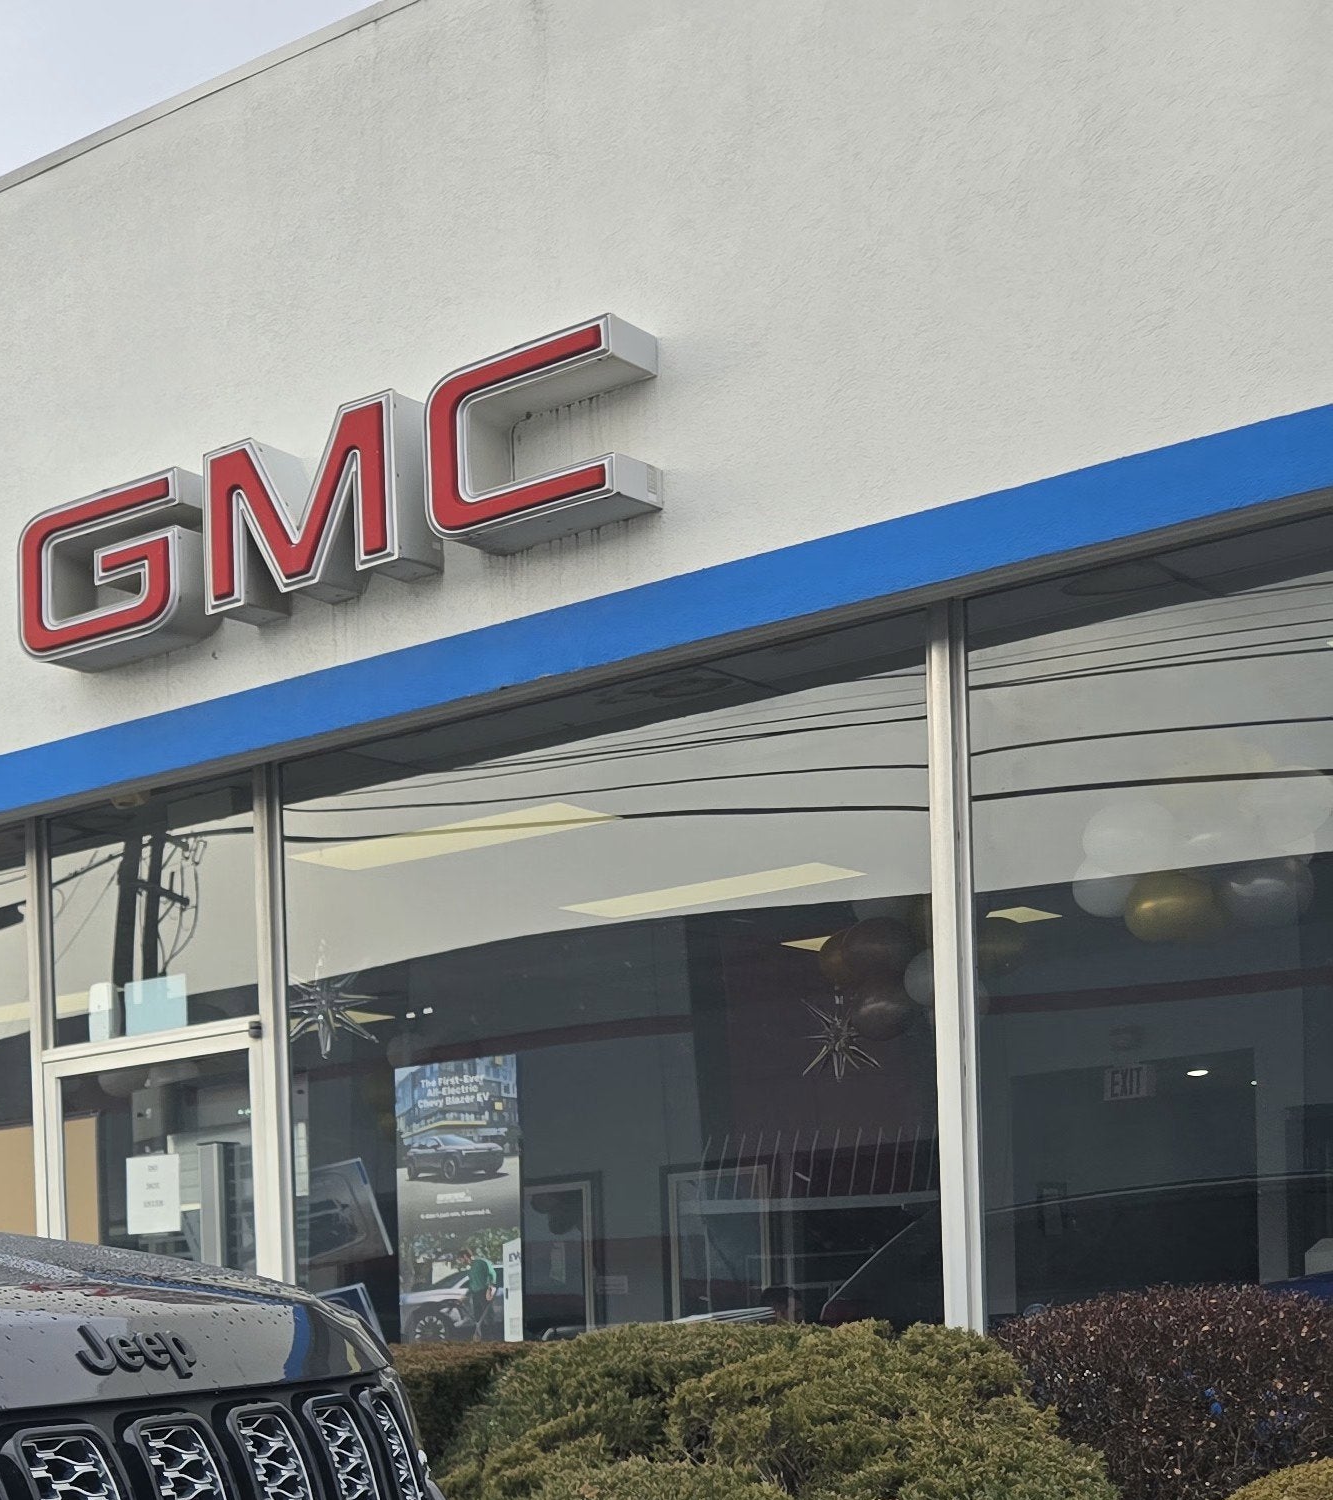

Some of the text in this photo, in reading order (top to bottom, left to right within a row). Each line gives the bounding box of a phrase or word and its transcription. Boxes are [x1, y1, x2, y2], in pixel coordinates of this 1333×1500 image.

[17, 312, 663, 672] GMC
[420, 1075, 484, 1089] The First-Ever
[427, 1085, 479, 1097] All-Electric
[1110, 1067, 1142, 1098] EXIT
[417, 1091, 490, 1109] Chevy Blazer EV
[75, 1324, 197, 1379] Jeep
